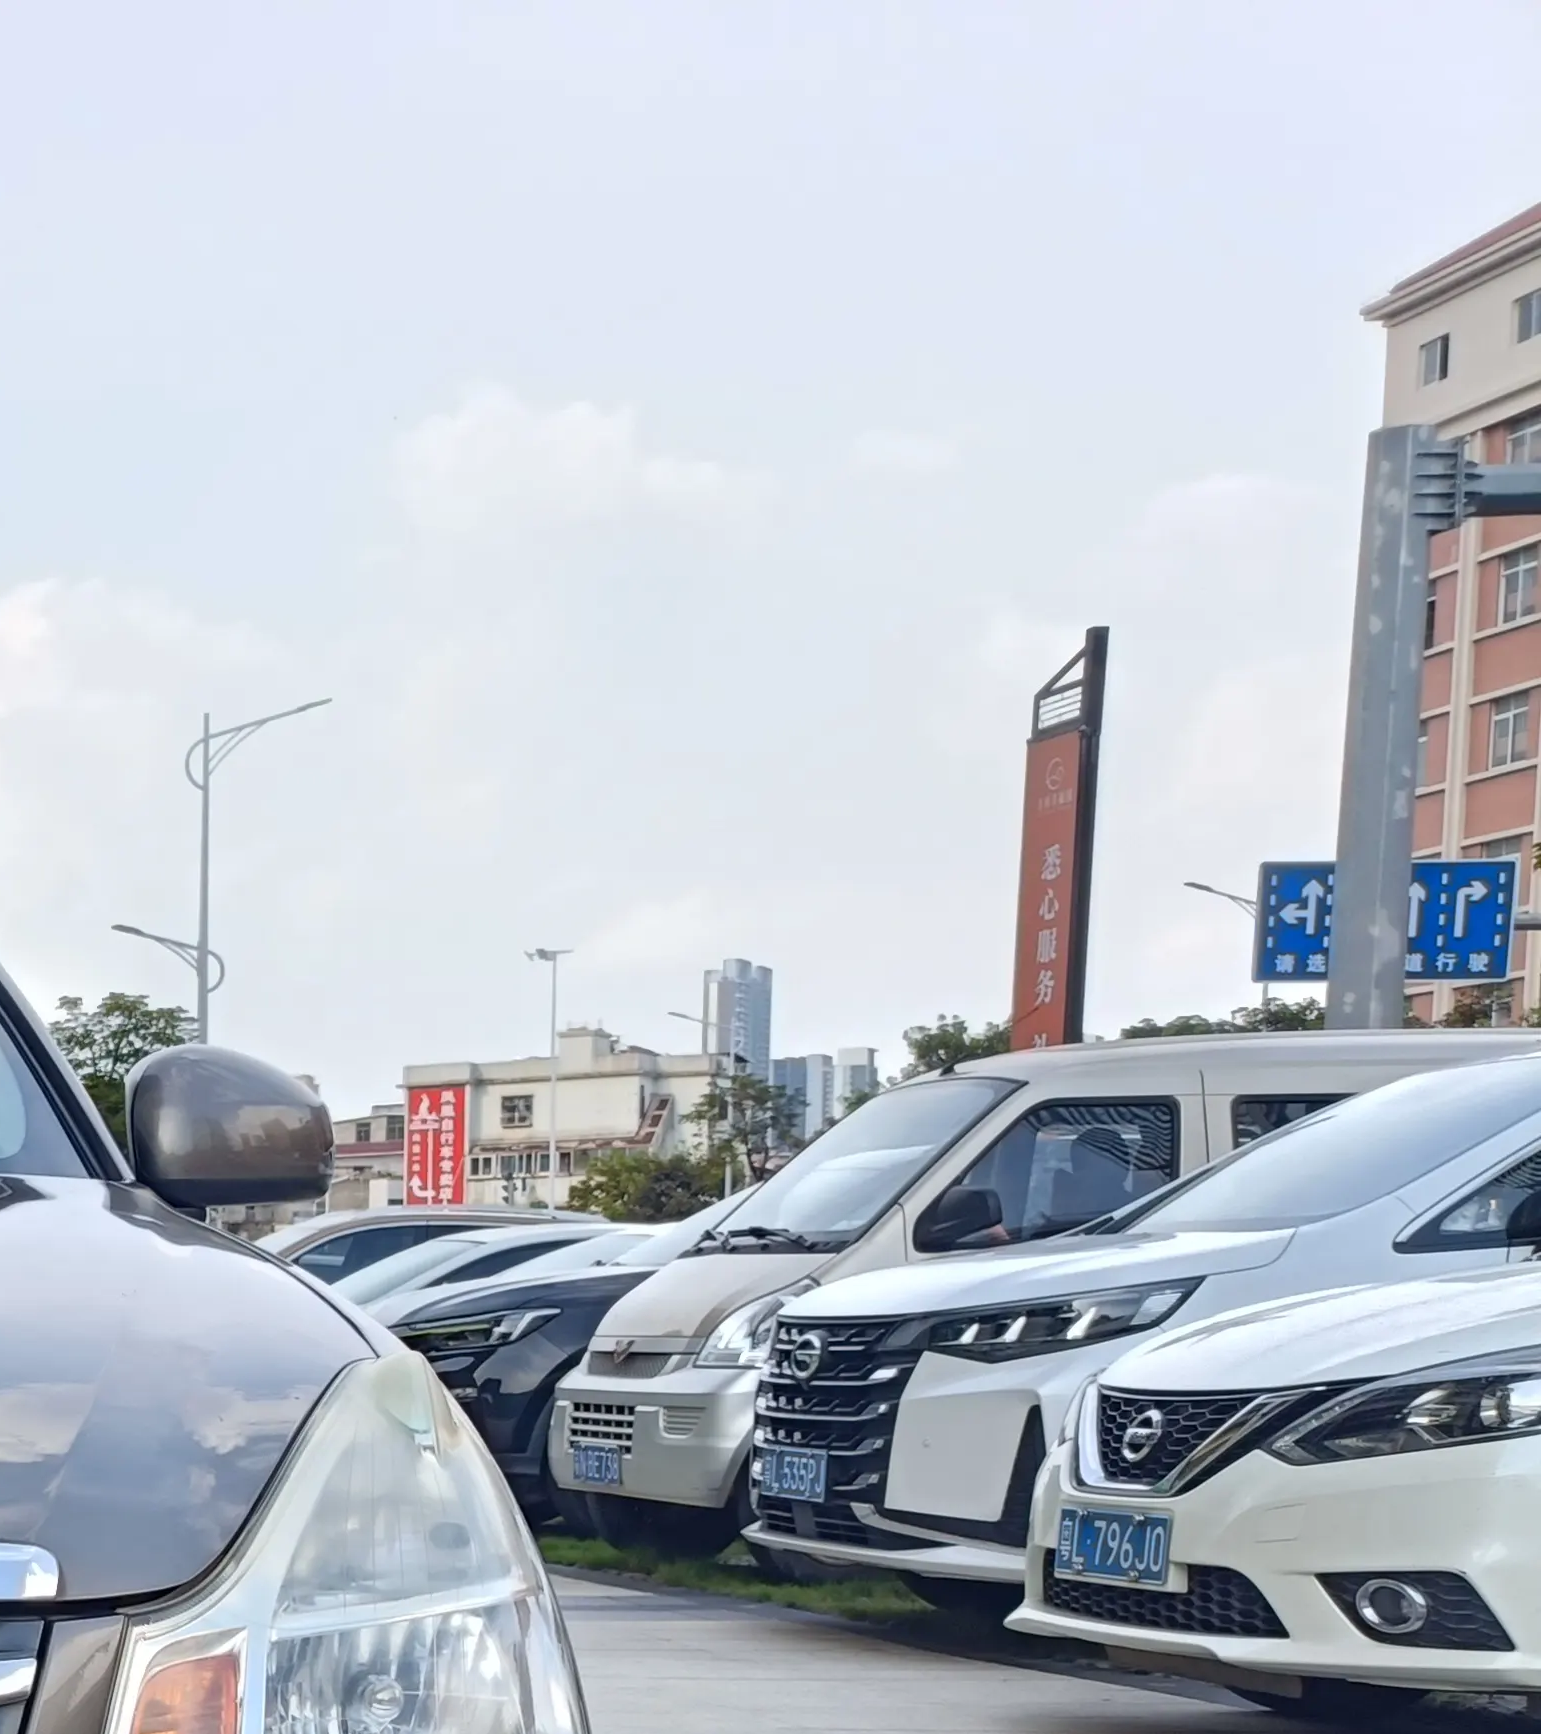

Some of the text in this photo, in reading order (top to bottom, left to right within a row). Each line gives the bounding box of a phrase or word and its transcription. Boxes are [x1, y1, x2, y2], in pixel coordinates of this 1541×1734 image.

[1035, 844, 1062, 1006] 悉心服务
[1275, 953, 1489, 973] 请选道行驶
